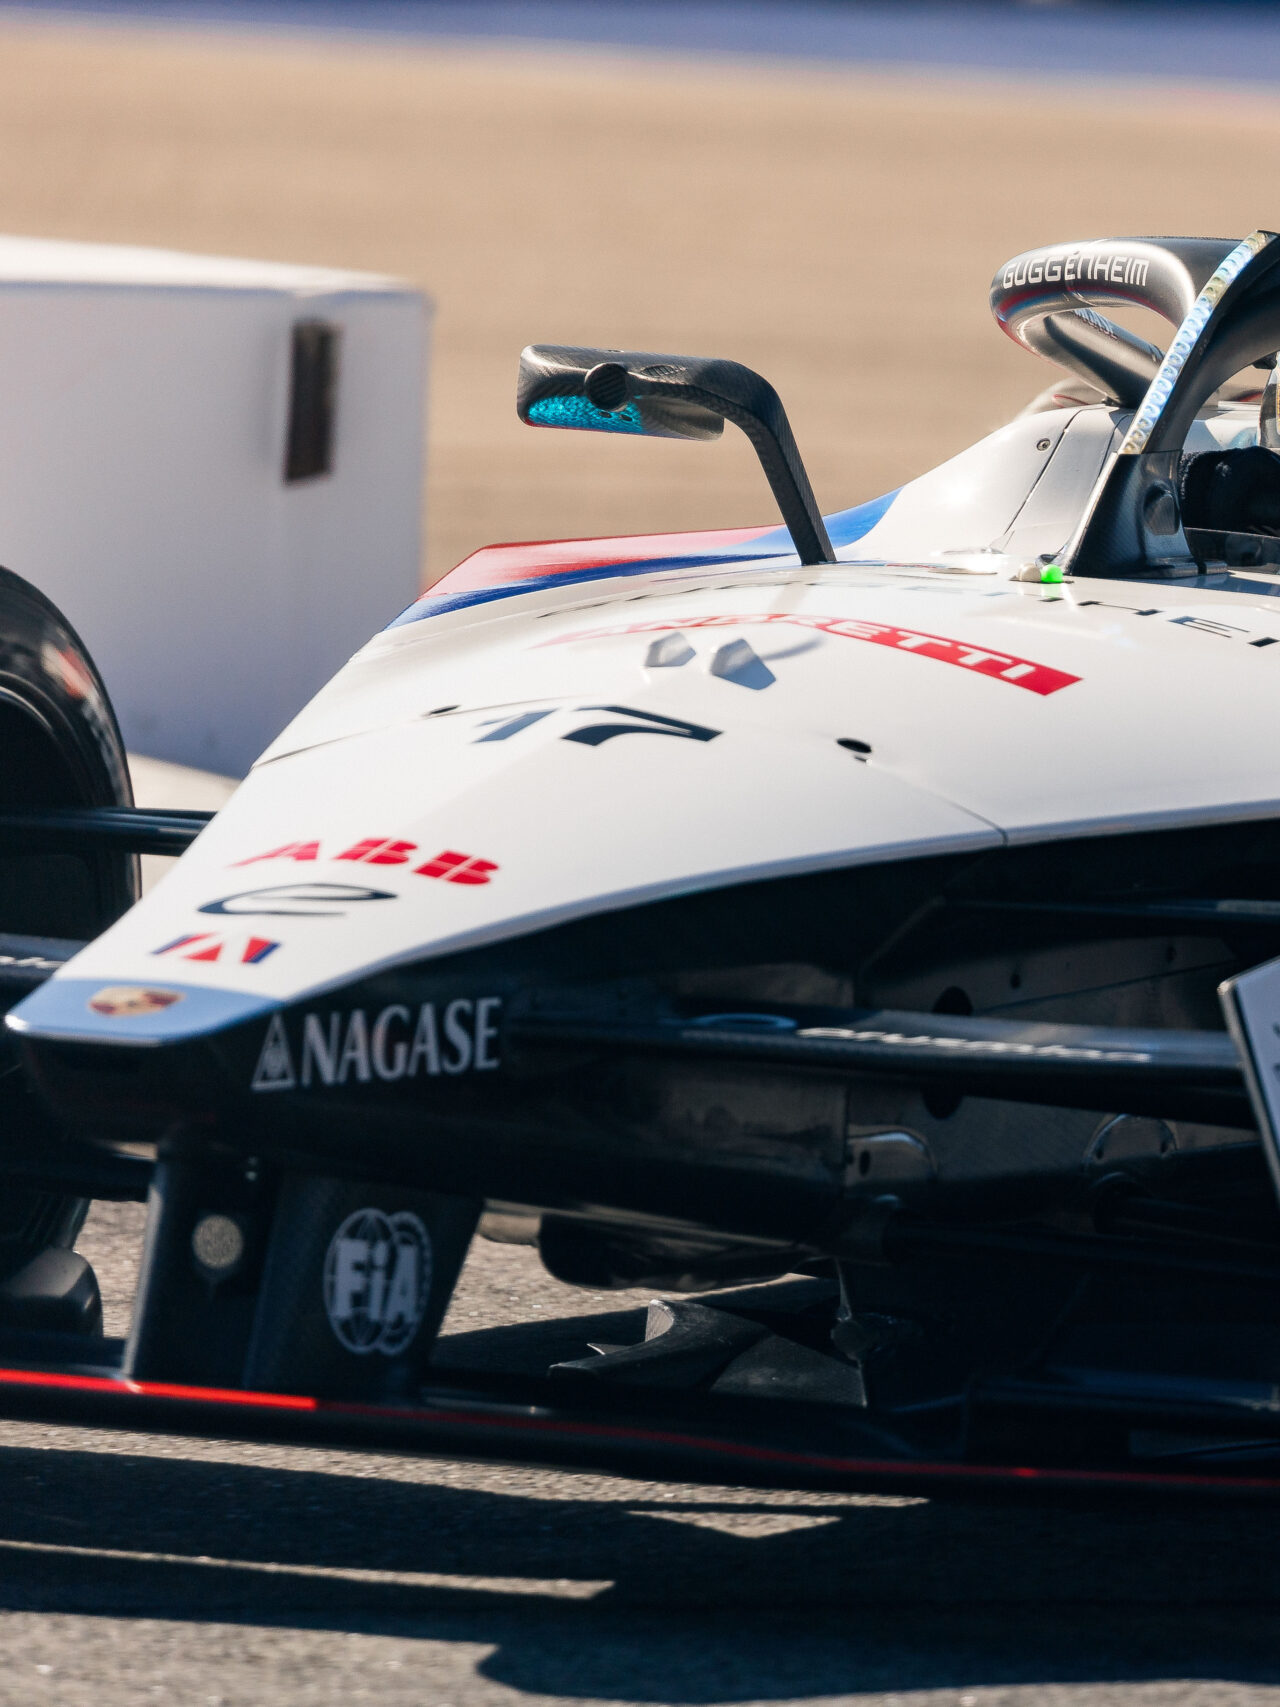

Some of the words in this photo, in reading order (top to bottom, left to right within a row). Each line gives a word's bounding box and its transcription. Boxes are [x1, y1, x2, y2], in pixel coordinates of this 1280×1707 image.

[1003, 255, 1150, 290] GUGGENHEIM
[226, 838, 500, 885] ABB
[302, 999, 500, 1086] NAGASE
